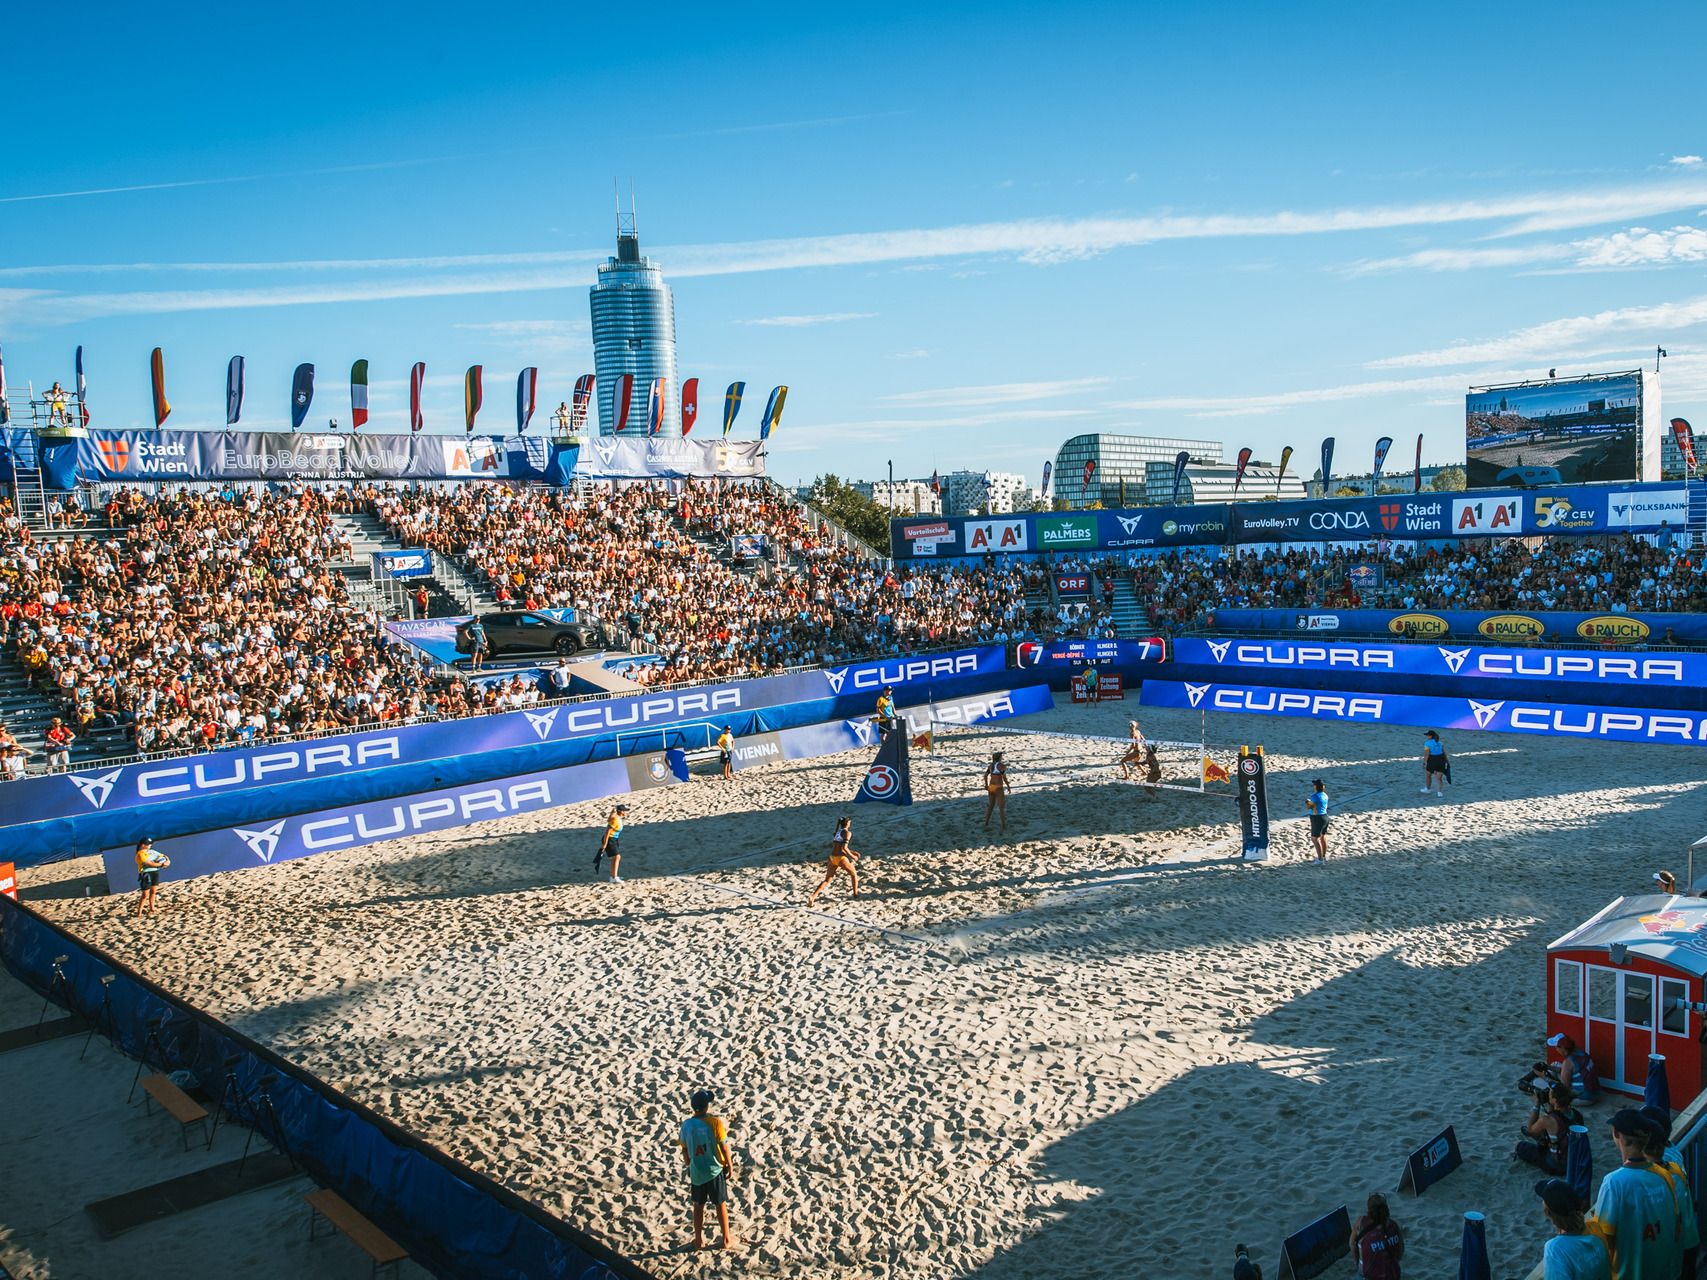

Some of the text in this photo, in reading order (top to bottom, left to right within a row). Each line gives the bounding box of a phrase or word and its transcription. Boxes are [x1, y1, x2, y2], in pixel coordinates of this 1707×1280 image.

[138, 441, 186, 456] Stadt
[139, 458, 188, 473] Wien
[223, 449, 419, 473] EuroBeachVolley
[328, 471, 366, 479] AUSTRIA
[1405, 502, 1442, 516] Stadt
[1458, 502, 1483, 529] A1
[1490, 501, 1517, 528] A1
[1571, 510, 1595, 519] CEV
[1178, 520, 1224, 535] myrobin
[1243, 517, 1300, 529] EuroVolley.TV
[1309, 510, 1370, 530] CONDA
[1405, 517, 1441, 530] Wien
[1559, 520, 1594, 529] Together
[908, 526, 946, 536] Vorteilsclub
[971, 524, 993, 549] A1
[1000, 523, 1022, 547] A1
[1043, 528, 1092, 540] PALMERS
[1107, 538, 1154, 546] CUPRA
[1059, 579, 1086, 589] ORF
[396, 621, 446, 632] TAVASCAN
[1496, 623, 1536, 634] RAUCH
[1596, 625, 1640, 637] RAUCH
[1031, 646, 1043, 665] 7
[1138, 641, 1150, 660] 7
[1237, 645, 1394, 668] CUPRA
[854, 654, 978, 688] CUPRA
[1478, 654, 1683, 681] CUPRA
[567, 688, 741, 732] CUPRA
[1214, 689, 1383, 718] CUPRA
[899, 696, 1014, 739] UPRA
[1510, 707, 1707, 741] CUPR
[735, 742, 780, 762] VIENNA
[137, 737, 400, 798] CUPRA
[301, 779, 551, 849] CUPRA
[1247, 779, 1261, 838] HITRADIO Ö3
